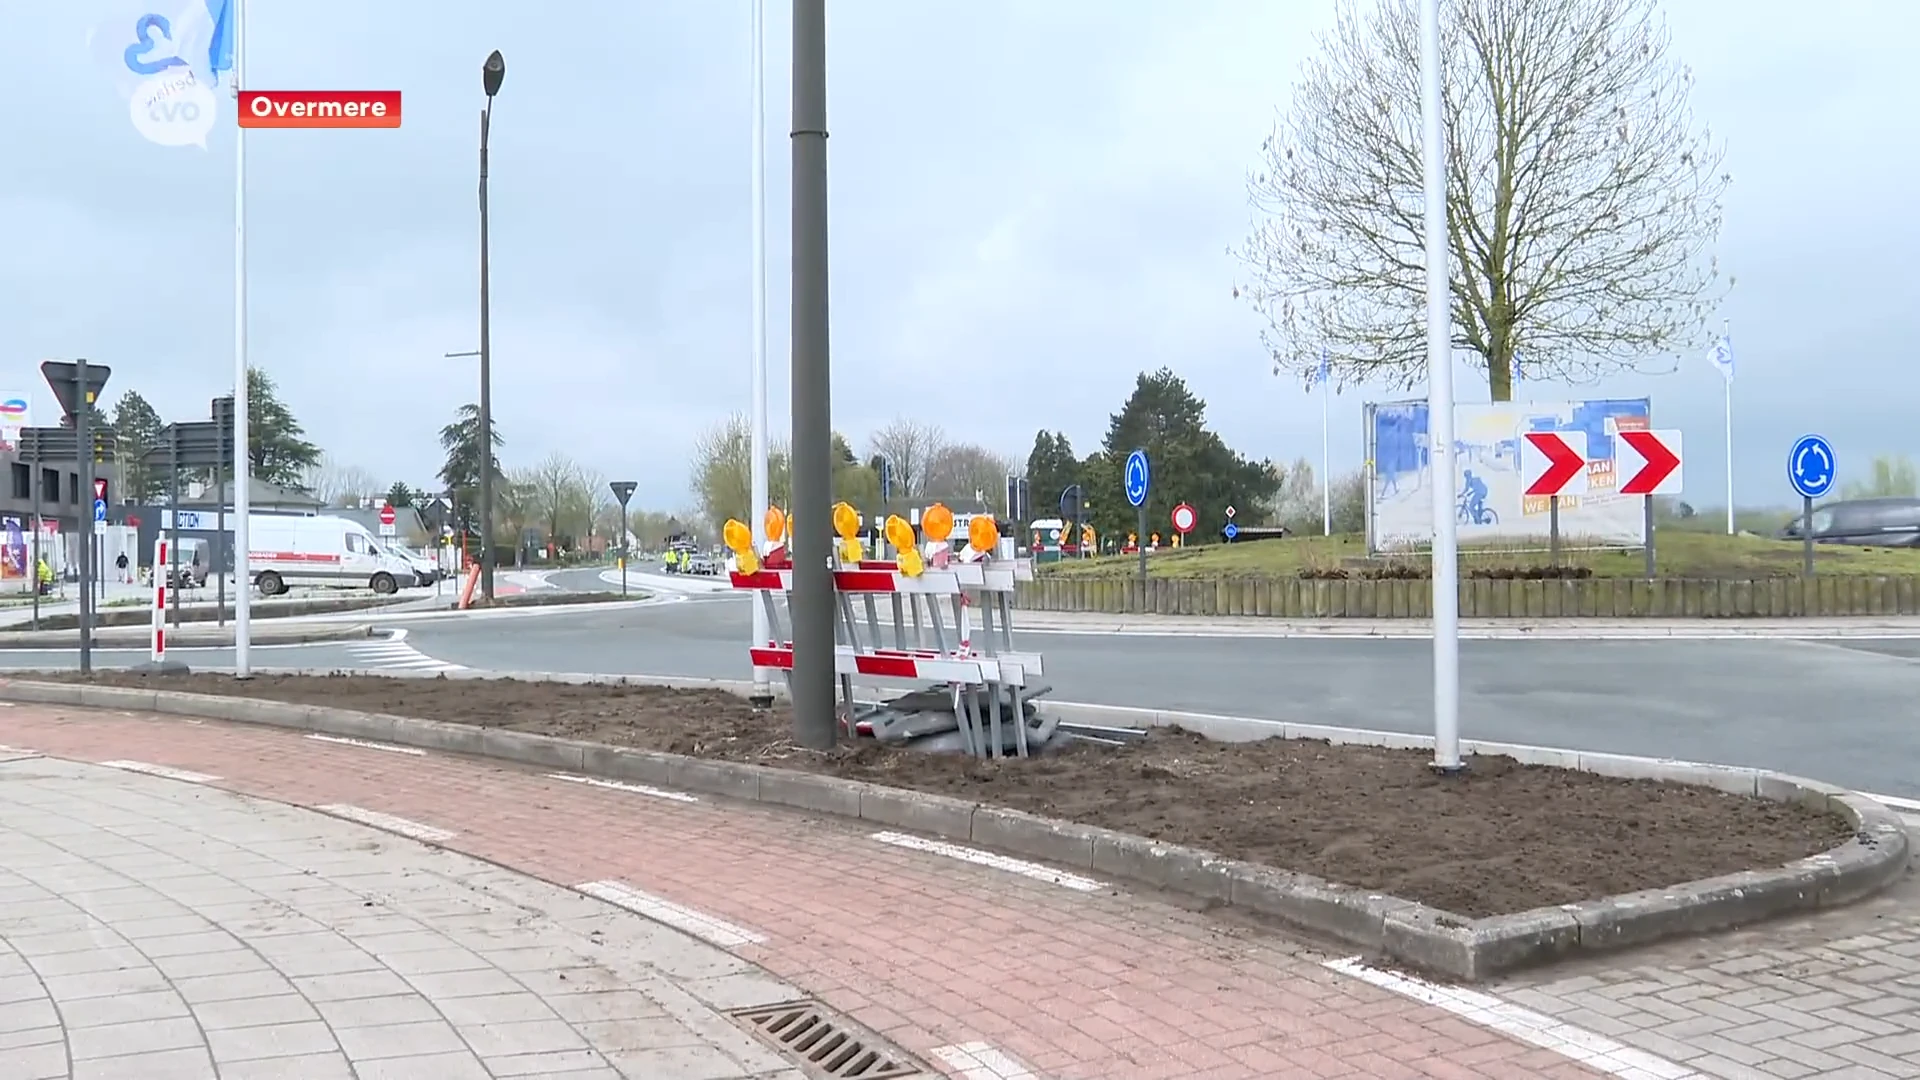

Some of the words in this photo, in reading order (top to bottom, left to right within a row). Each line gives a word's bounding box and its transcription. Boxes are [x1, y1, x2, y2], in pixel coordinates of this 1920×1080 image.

[1588, 476, 1614, 488] KEN
[1525, 500, 1545, 514] WE
[178, 512, 200, 528] OTION
[953, 519, 969, 527] STR
